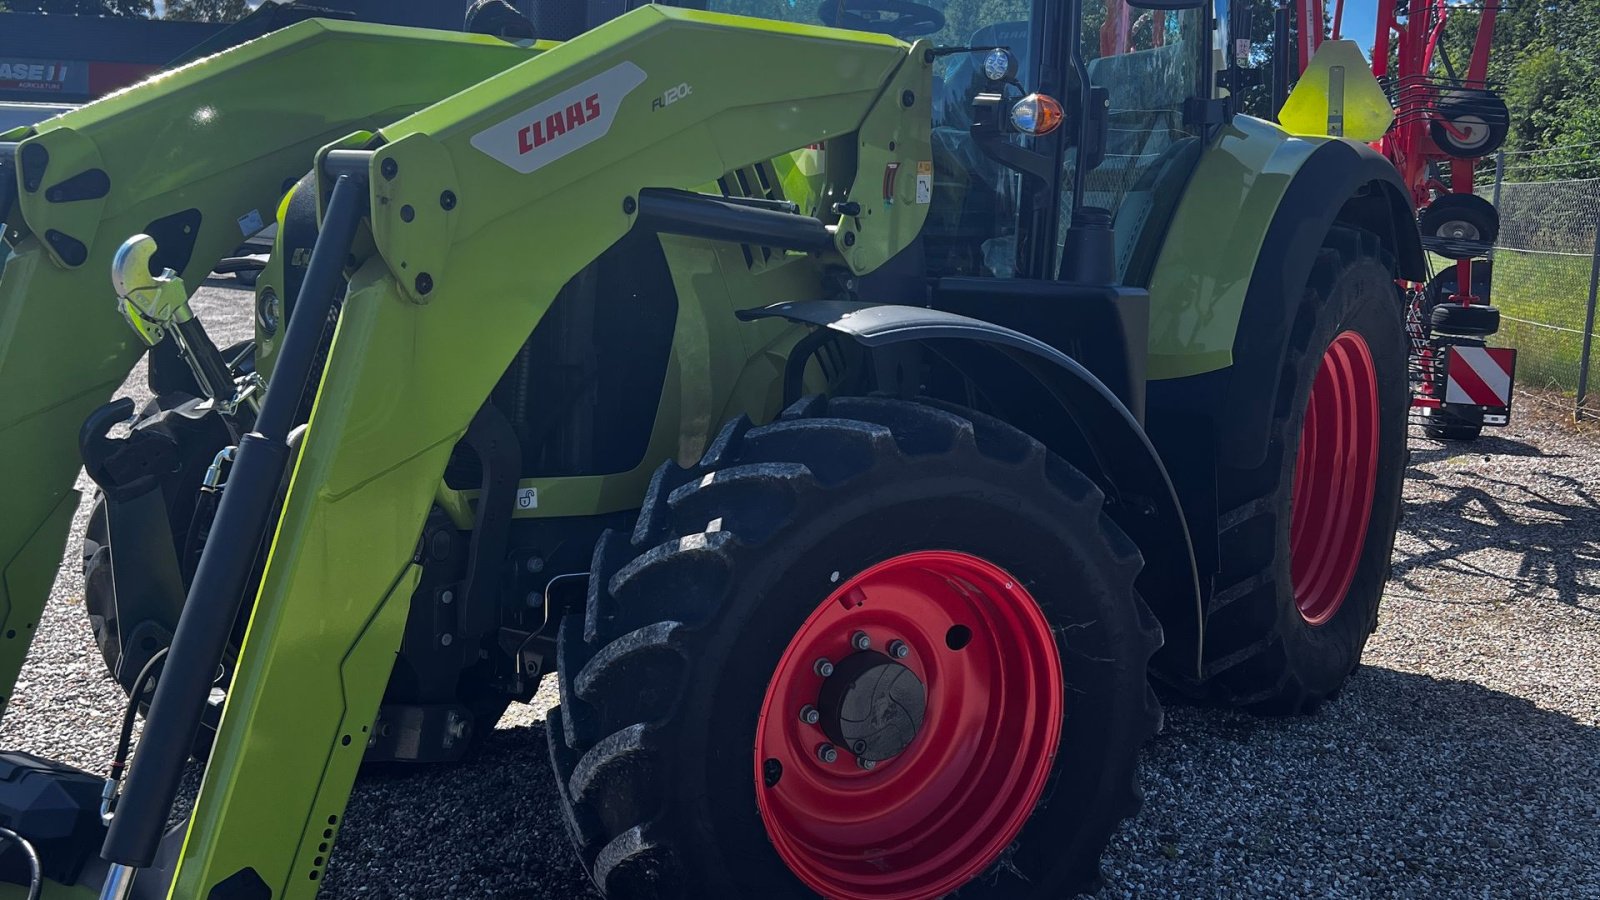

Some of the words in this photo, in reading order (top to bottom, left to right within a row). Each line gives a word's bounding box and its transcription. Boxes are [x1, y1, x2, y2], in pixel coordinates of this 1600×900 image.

[0, 63, 44, 81] ASE
[18, 82, 61, 90] AGRICULTURE
[517, 93, 602, 155] CLAAS
